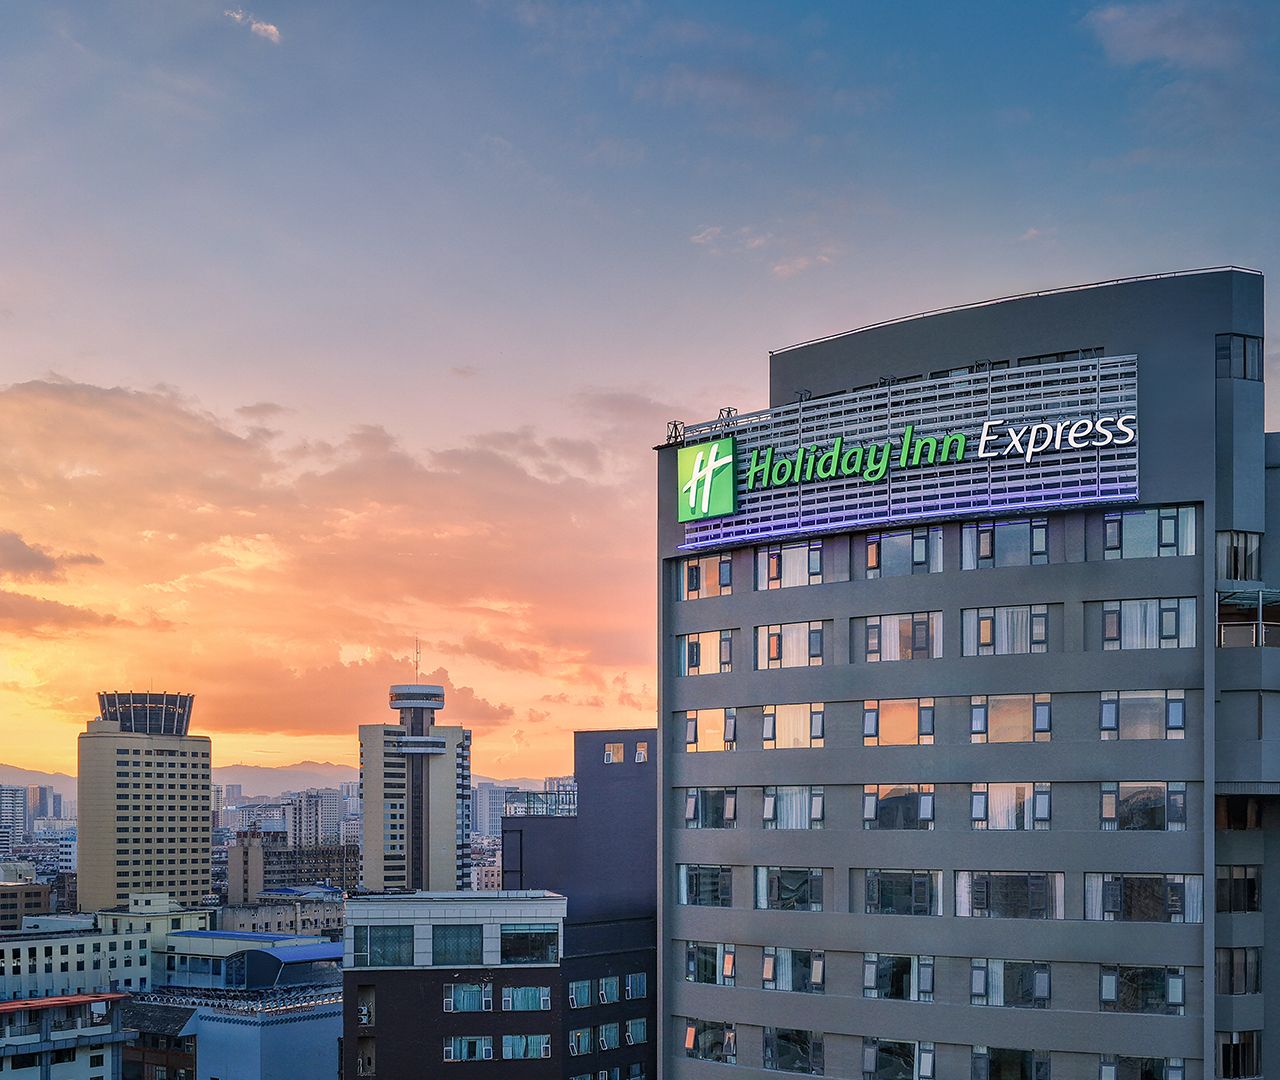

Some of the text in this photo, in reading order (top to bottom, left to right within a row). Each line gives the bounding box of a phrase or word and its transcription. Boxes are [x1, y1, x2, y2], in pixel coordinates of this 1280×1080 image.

[745, 441, 893, 490] Holiday
[899, 424, 967, 469] Inn
[977, 413, 1137, 463] Express
